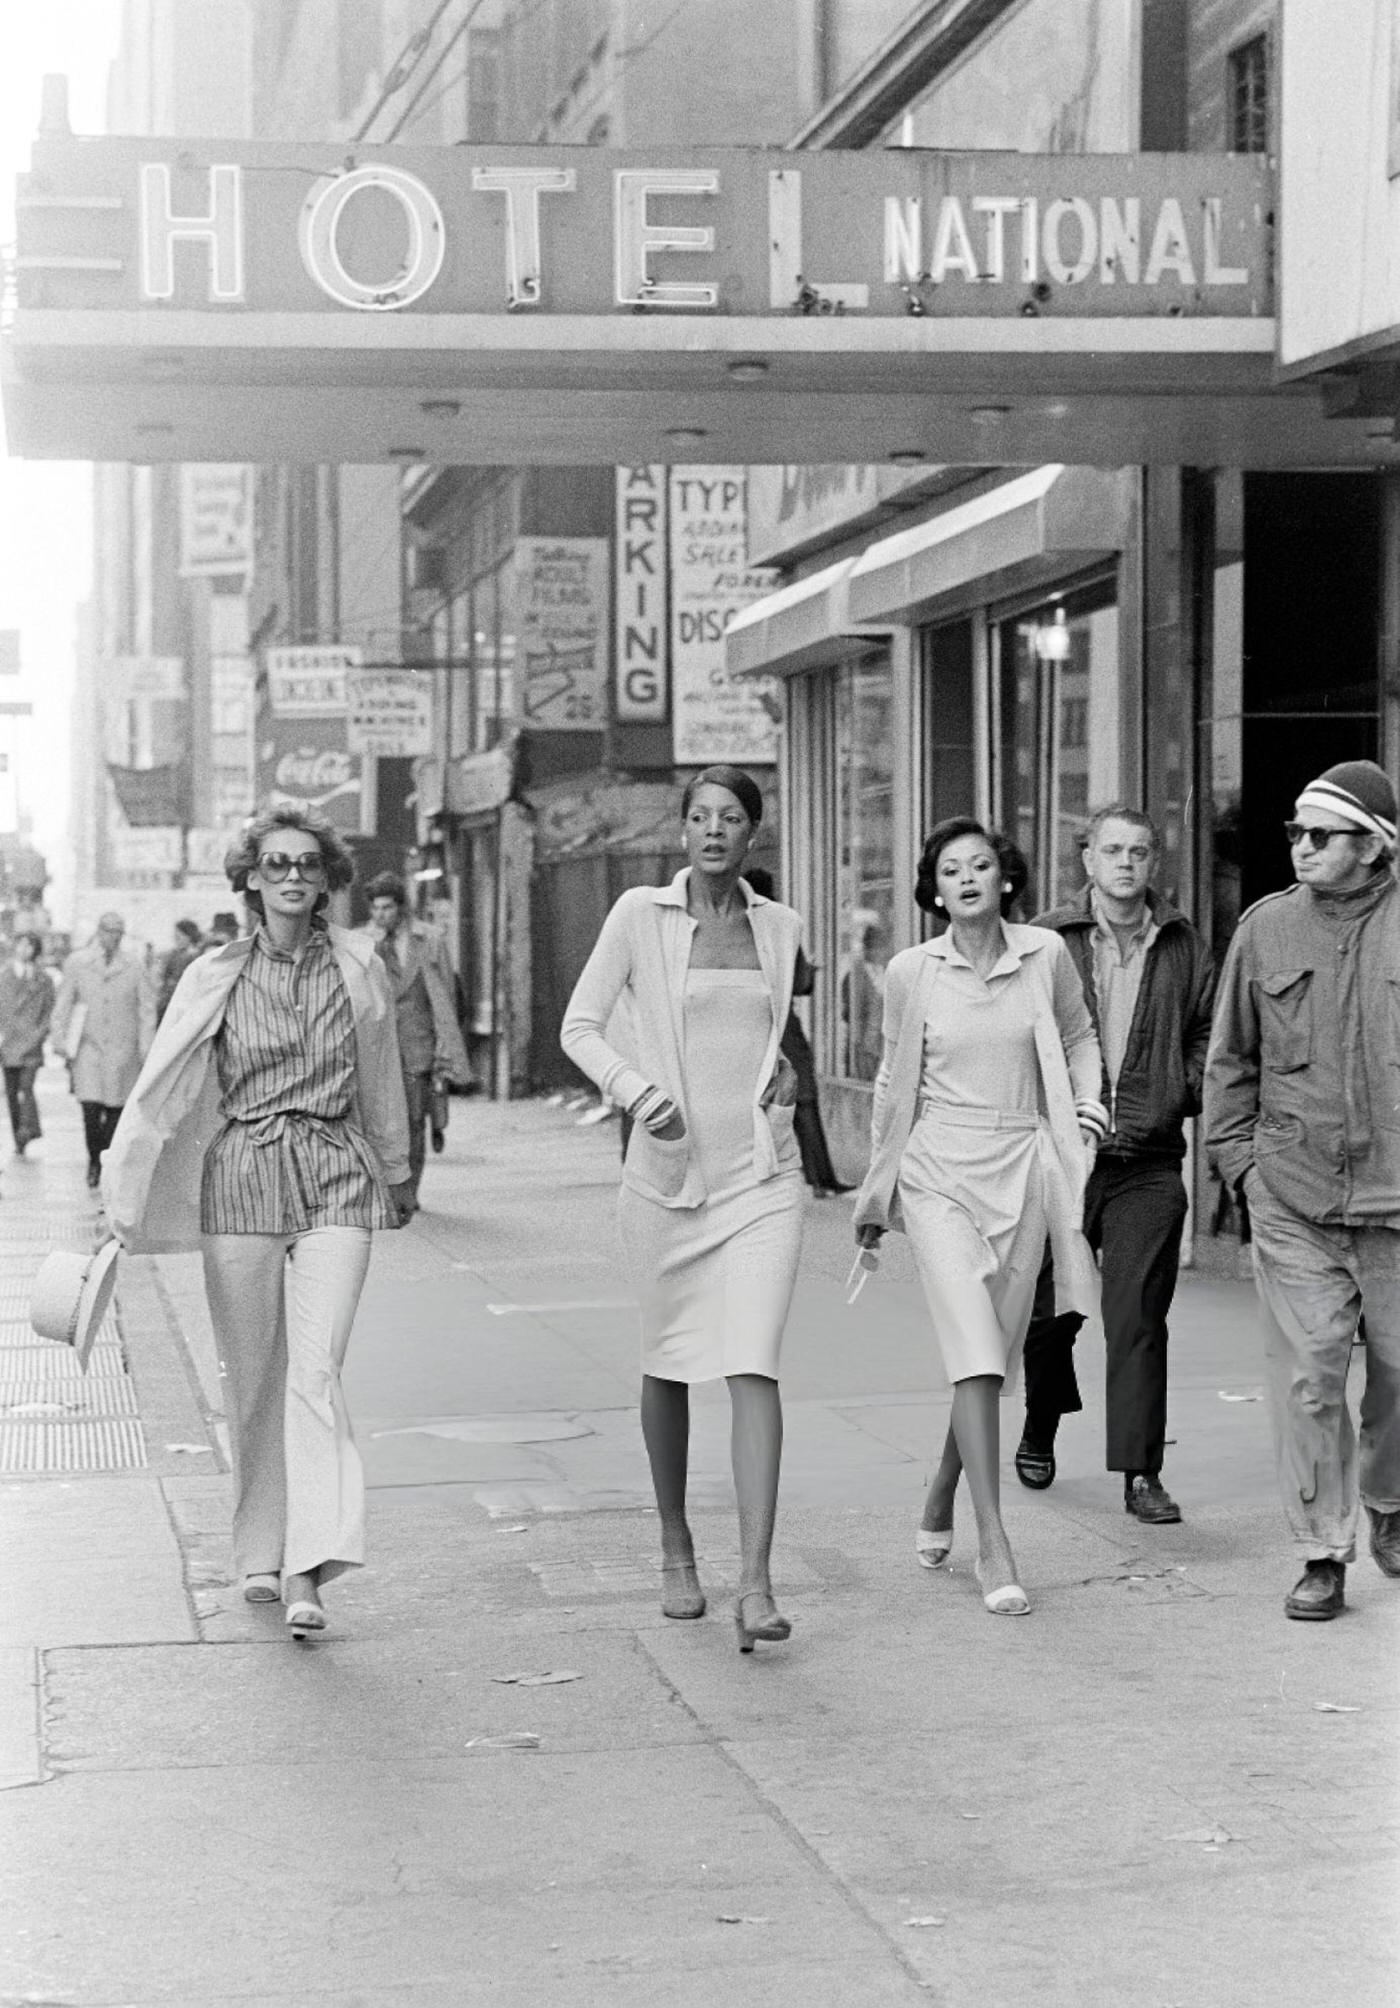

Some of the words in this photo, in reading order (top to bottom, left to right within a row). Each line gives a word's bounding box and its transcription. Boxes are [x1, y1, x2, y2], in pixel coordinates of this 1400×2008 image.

[140, 162, 869, 310] HOTEL
[884, 195, 1249, 285] NATIONAL
[677, 480, 739, 511] TYP
